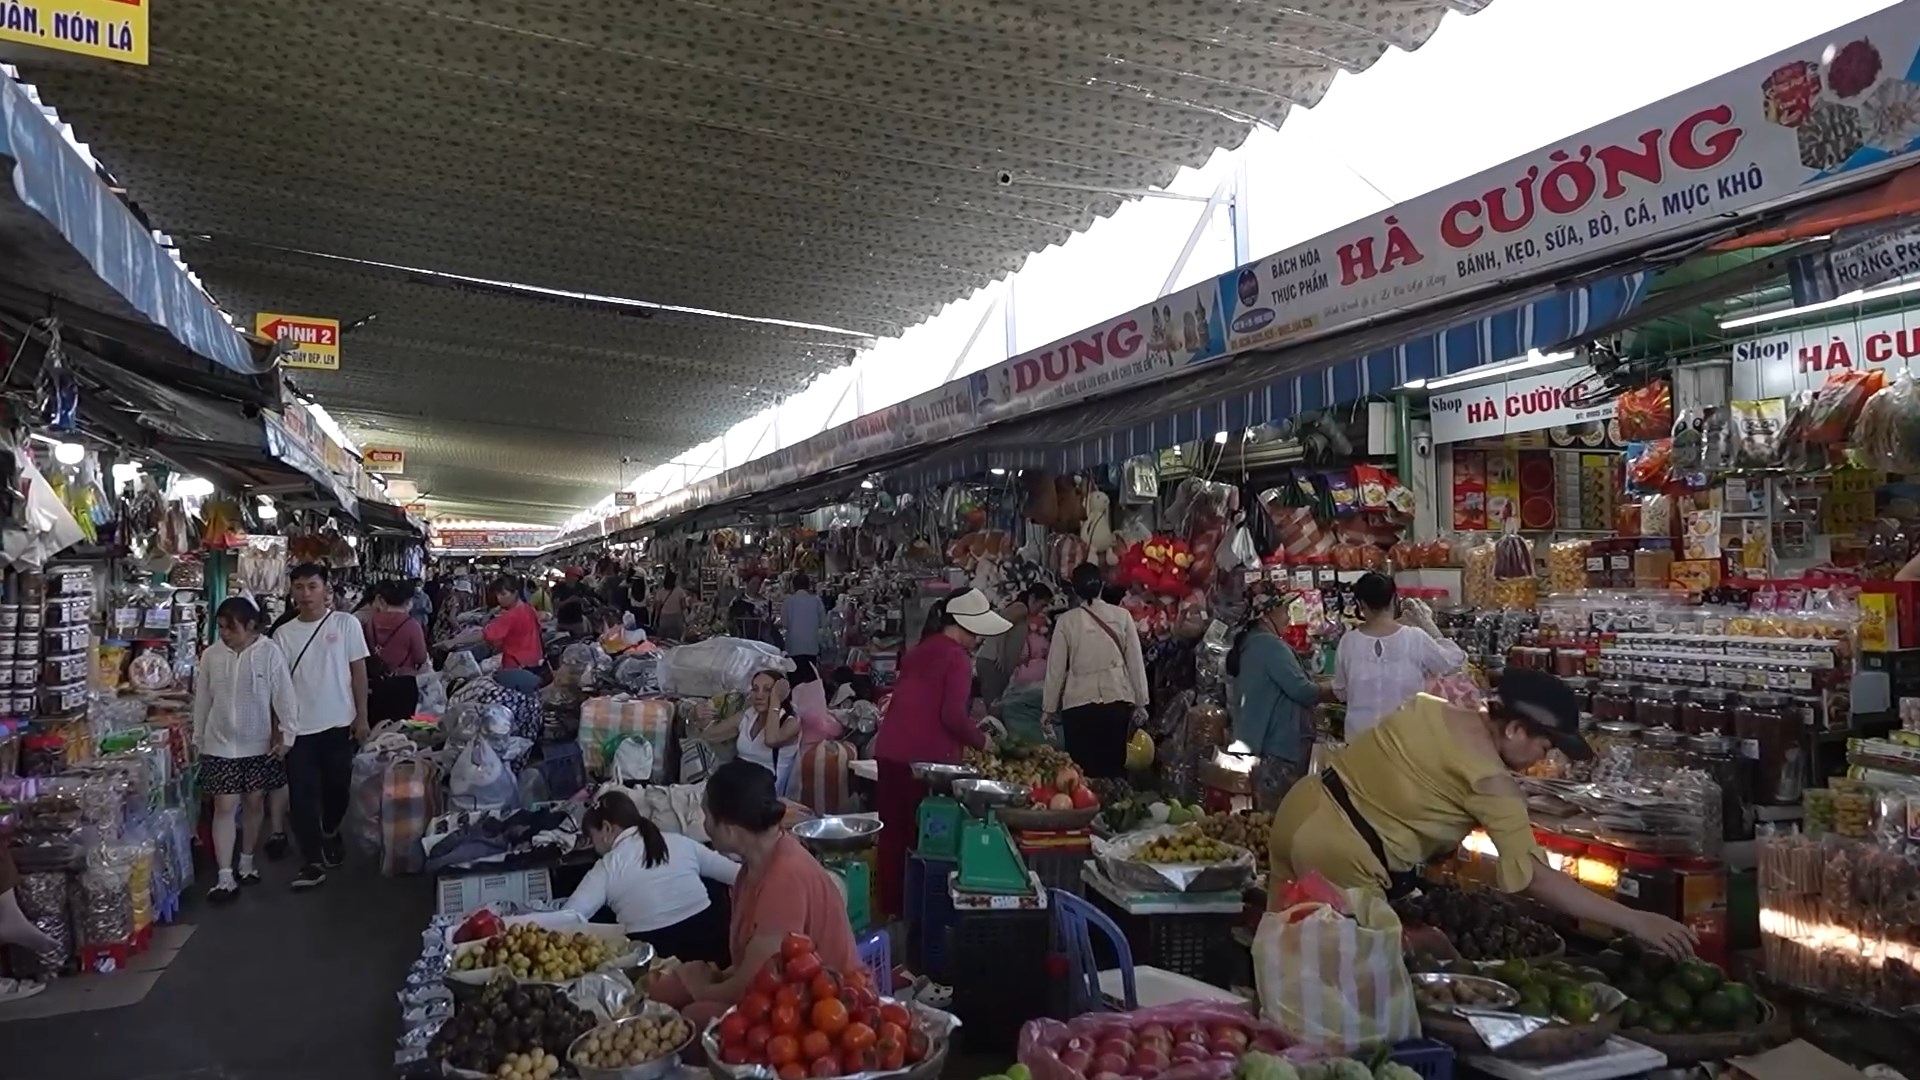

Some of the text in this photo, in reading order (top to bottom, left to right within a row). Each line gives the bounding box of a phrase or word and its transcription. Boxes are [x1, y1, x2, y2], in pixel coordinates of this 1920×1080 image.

[55, 11, 99, 45] NÓN
[108, 21, 132, 52] LÁ
[1336, 104, 1743, 287] HÀ CƯỜNG
[1456, 162, 1763, 278] BÁNH, KẸO, SỮA, BÒ, CÁ, MỰC KHÔ
[1271, 258, 1298, 279] BÁCH
[321, 329, 332, 344] 2
[1736, 340, 1789, 363] Shop
[1798, 336, 1852, 374] HÀ
[1431, 397, 1462, 413] Shop
[1467, 396, 1499, 424] HÀ
